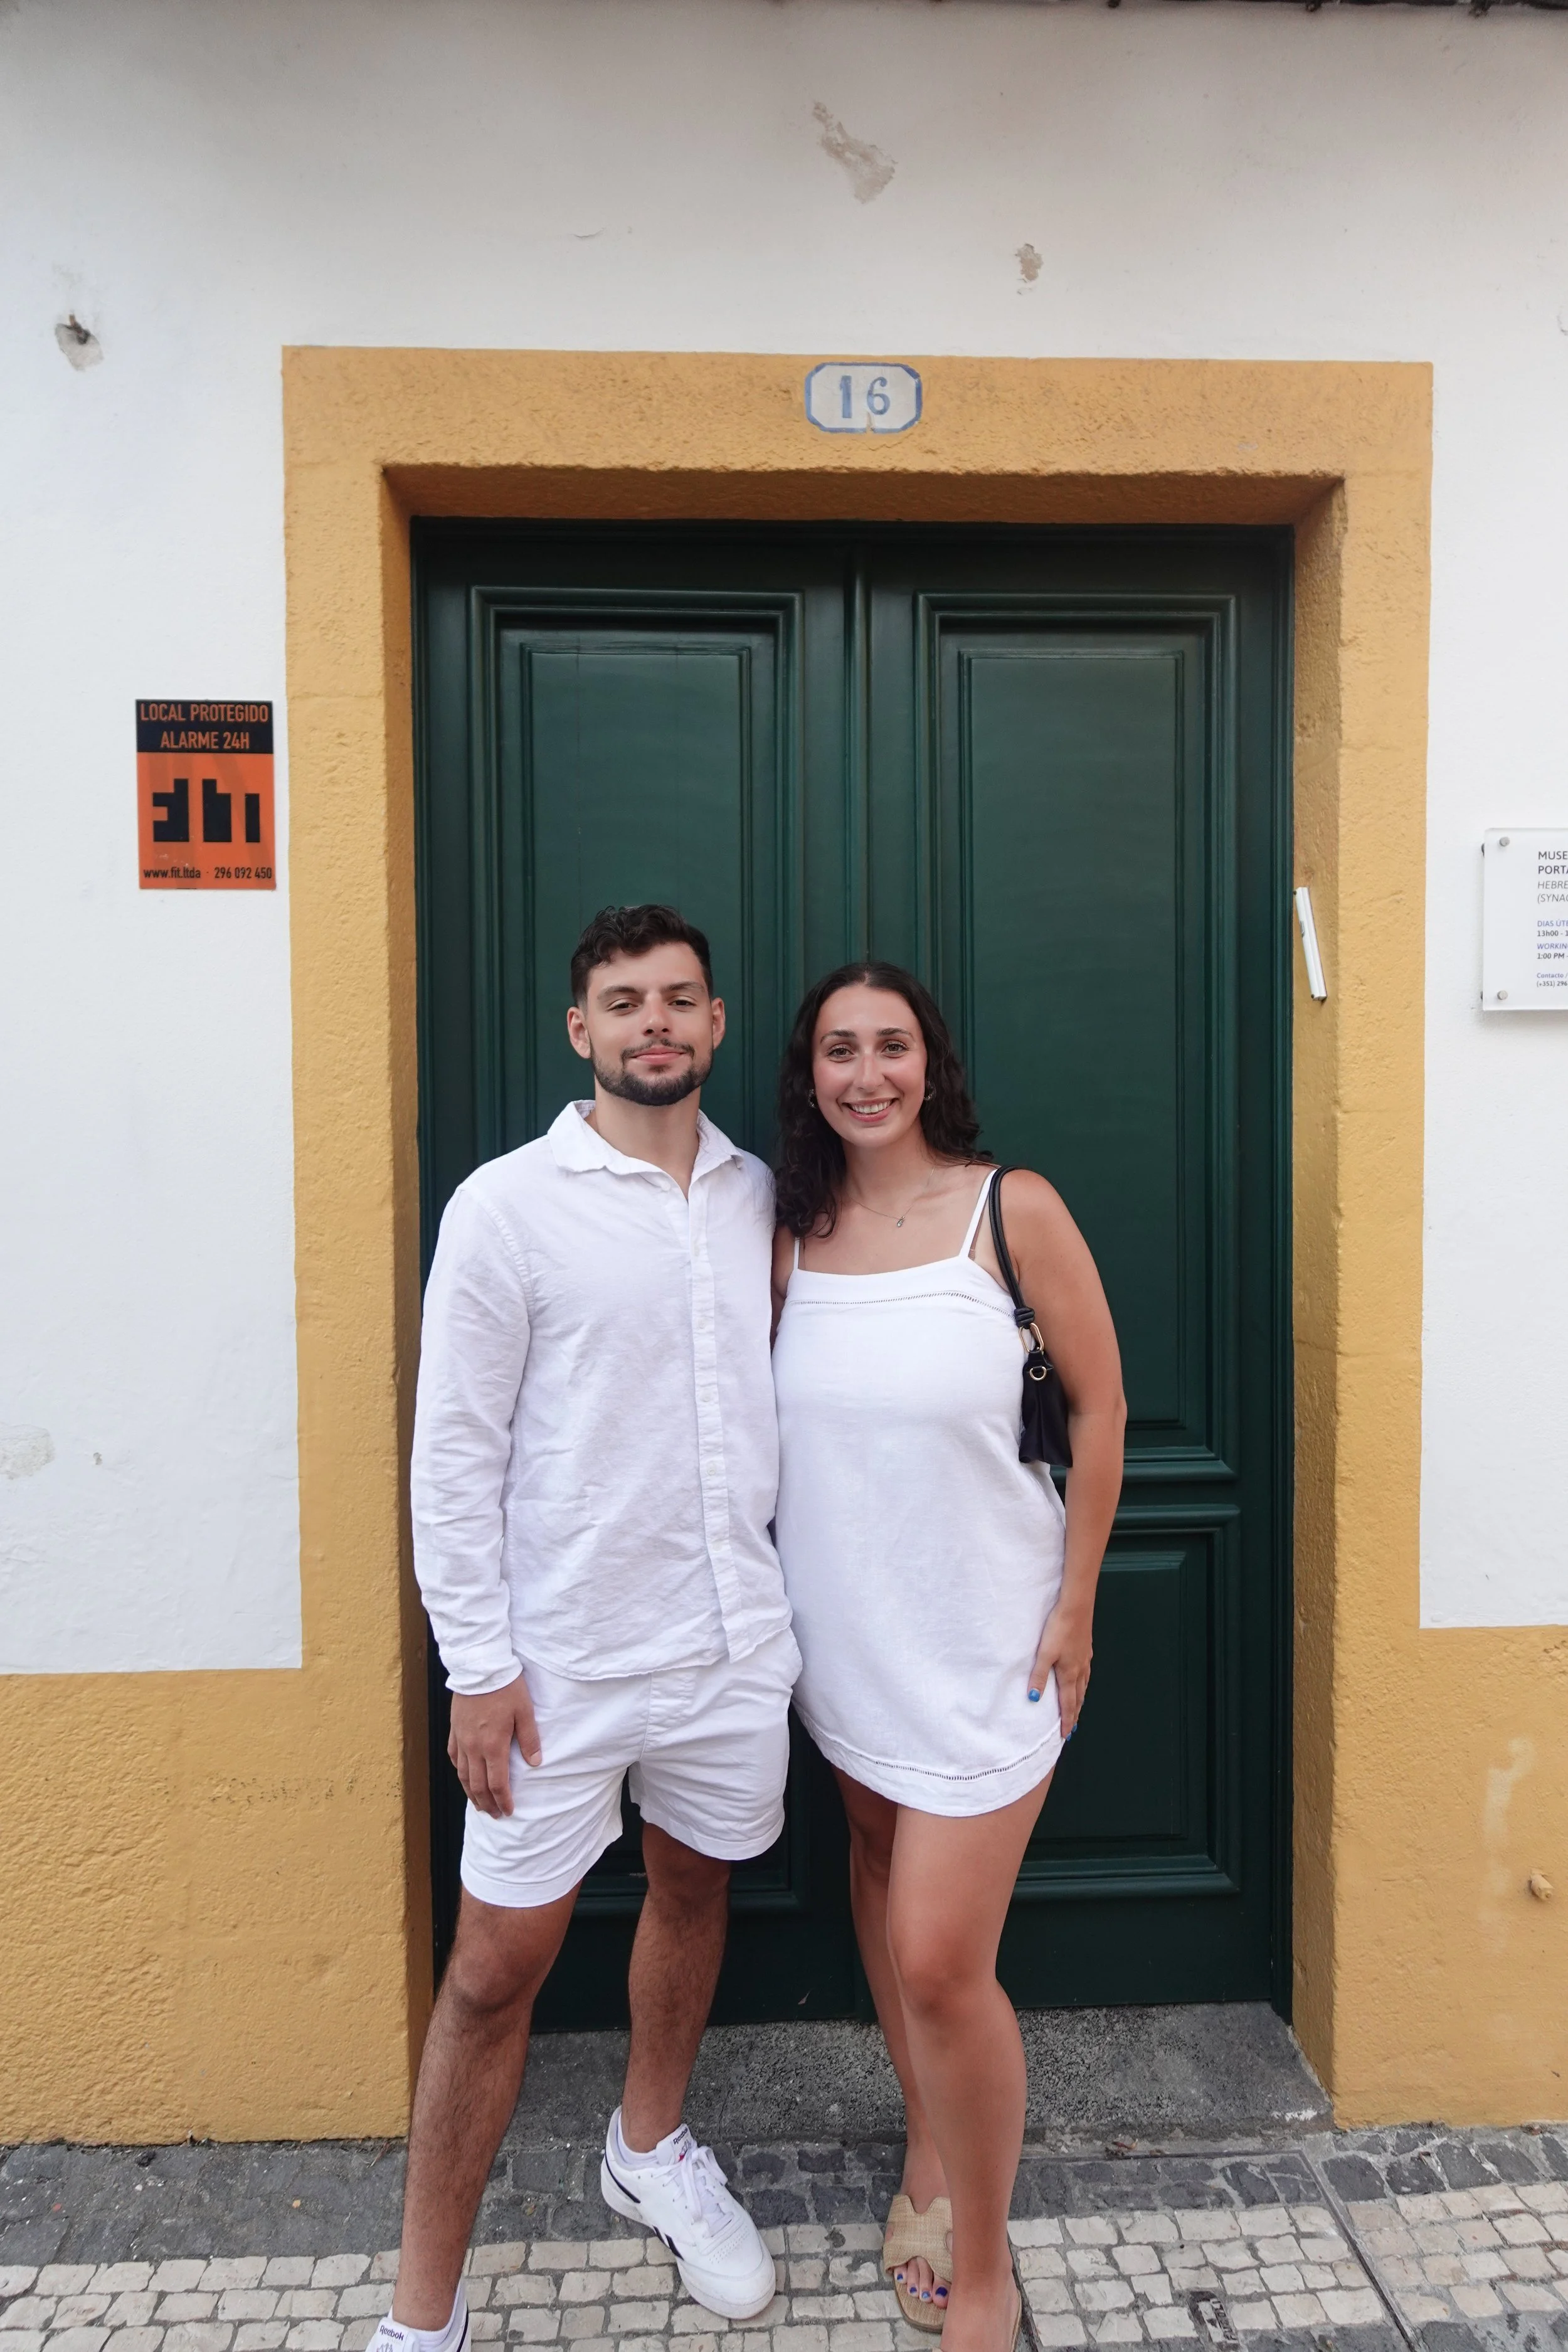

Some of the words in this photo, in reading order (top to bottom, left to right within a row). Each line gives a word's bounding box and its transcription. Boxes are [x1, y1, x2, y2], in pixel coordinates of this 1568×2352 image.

[839, 375, 891, 418] 16
[140, 703, 186, 721] LOCAL
[189, 704, 269, 723] PROTEGIDO
[160, 731, 219, 749] ALARME
[223, 731, 250, 750] 24H
[215, 867, 231, 878] 296
[235, 867, 252, 878] 092
[254, 867, 272, 879] 450
[1538, 865, 1568, 875] PORT
[379, 2324, 405, 2341] Reebok
